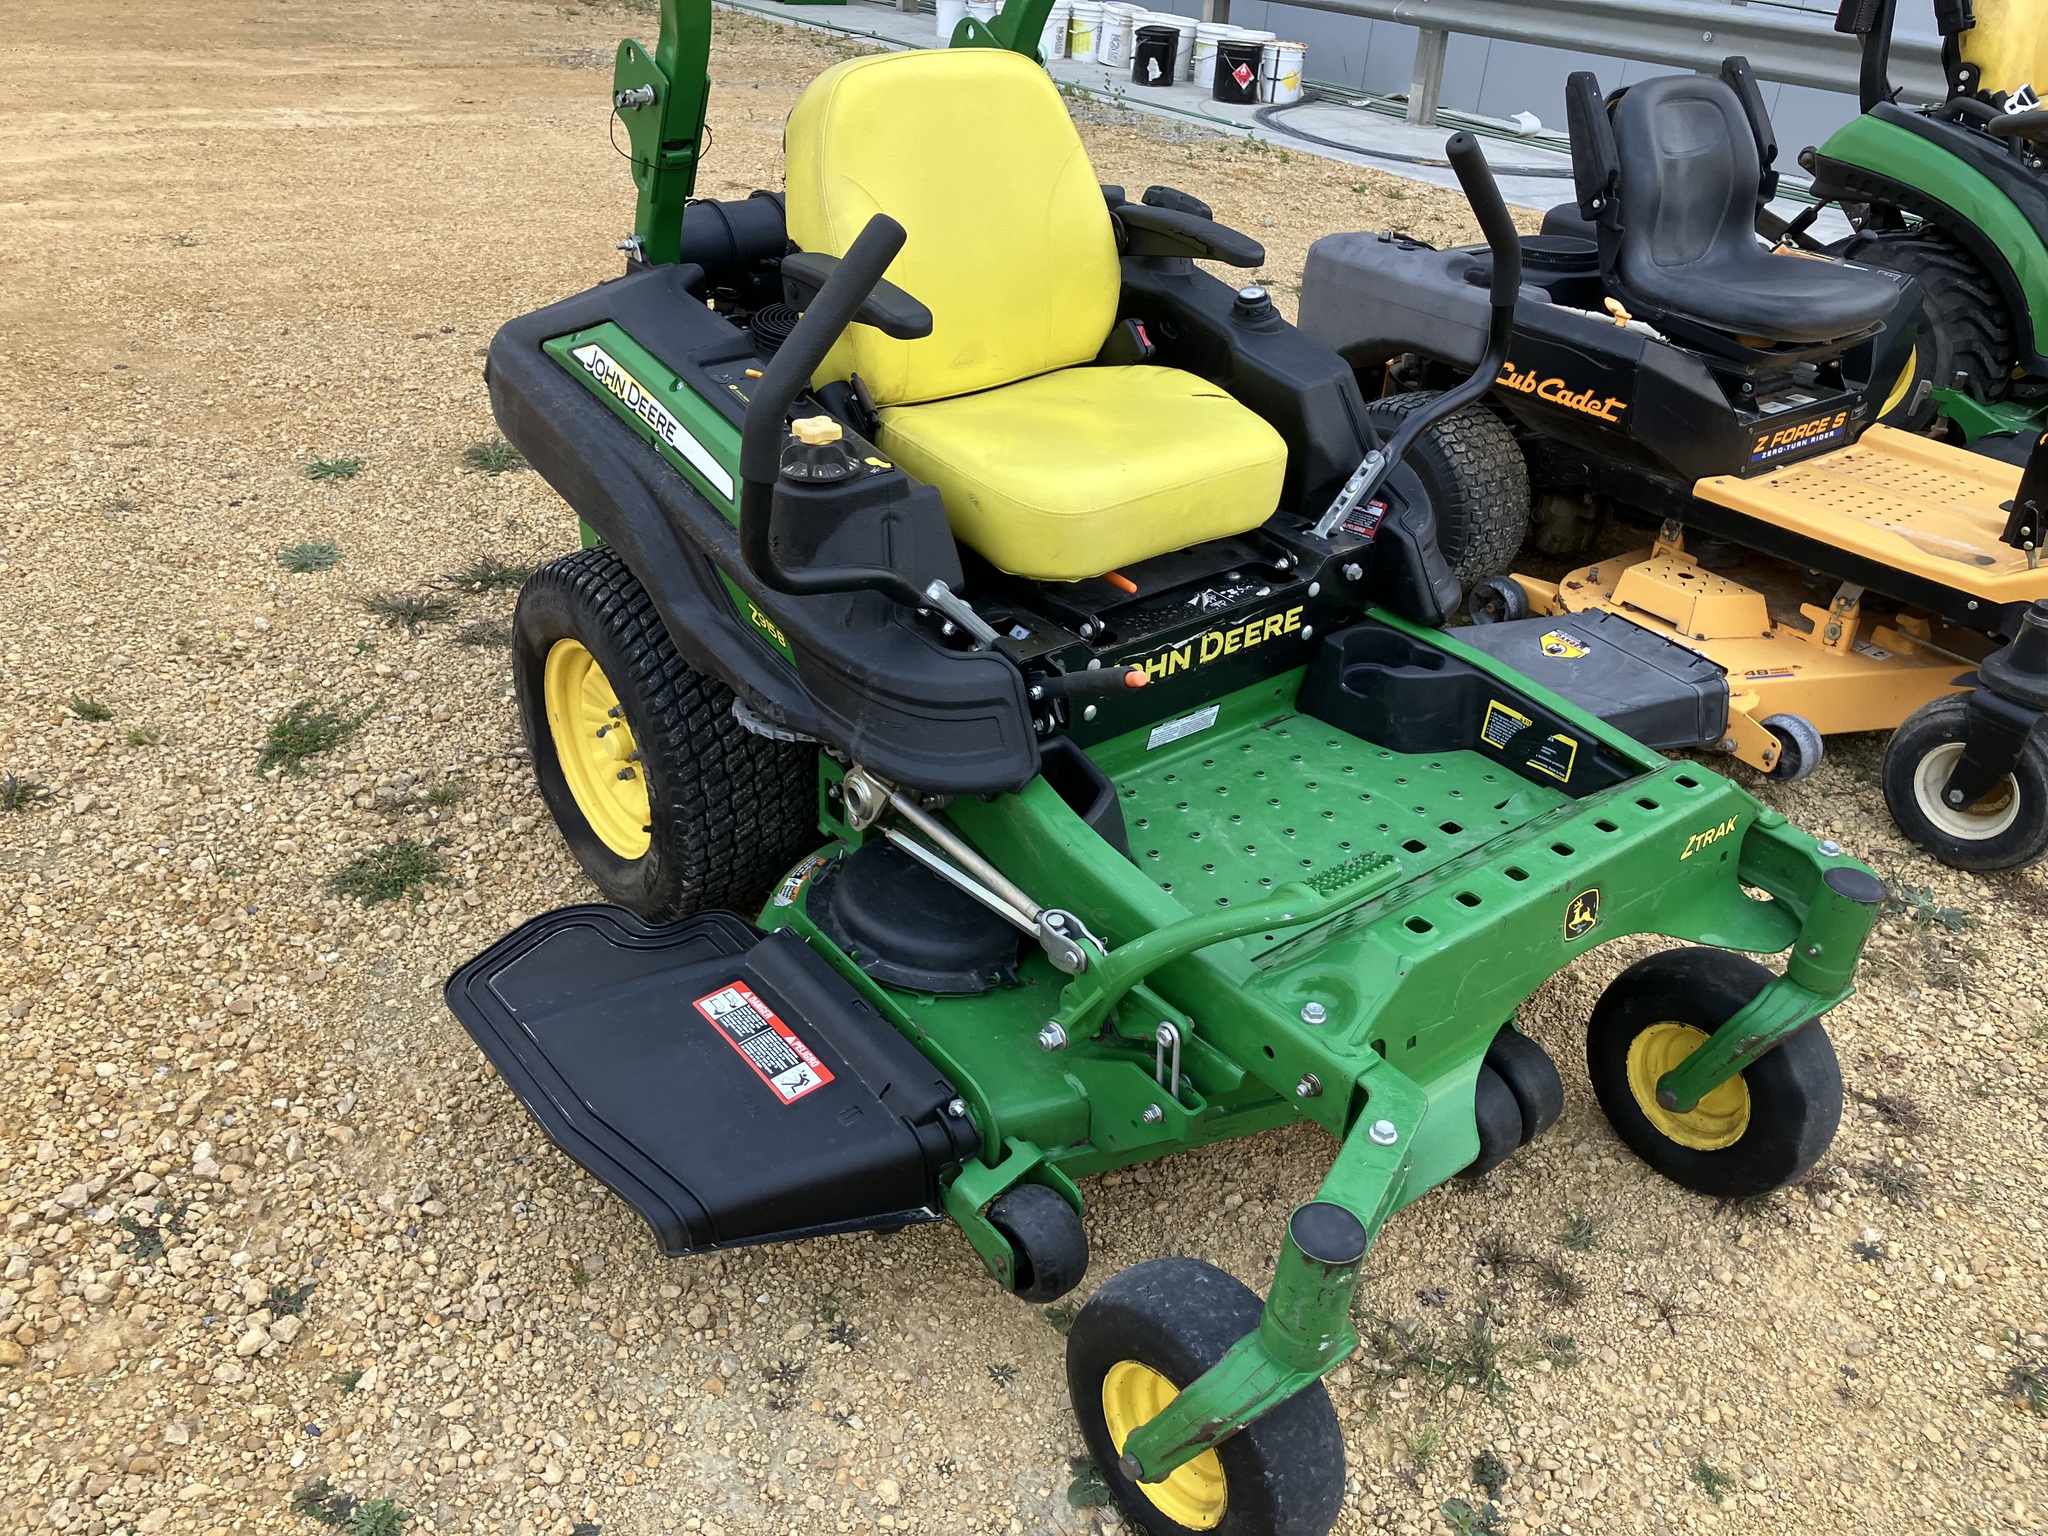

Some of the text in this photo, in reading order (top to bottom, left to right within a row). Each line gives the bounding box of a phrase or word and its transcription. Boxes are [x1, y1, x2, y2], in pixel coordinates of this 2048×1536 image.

[586, 349, 678, 443] JOHN DEERE
[1495, 361, 1628, 423] Cub Cadet
[1752, 434, 1770, 454] Z
[1769, 416, 1831, 449] FORCE
[1831, 410, 1848, 430] S
[1810, 430, 1835, 444] RIDER
[1113, 605, 1304, 684] HN DEERE
[1680, 813, 1739, 861] ZTRAK
[747, 995, 774, 1019] DANGER
[791, 1040, 820, 1068] PELIGRO
